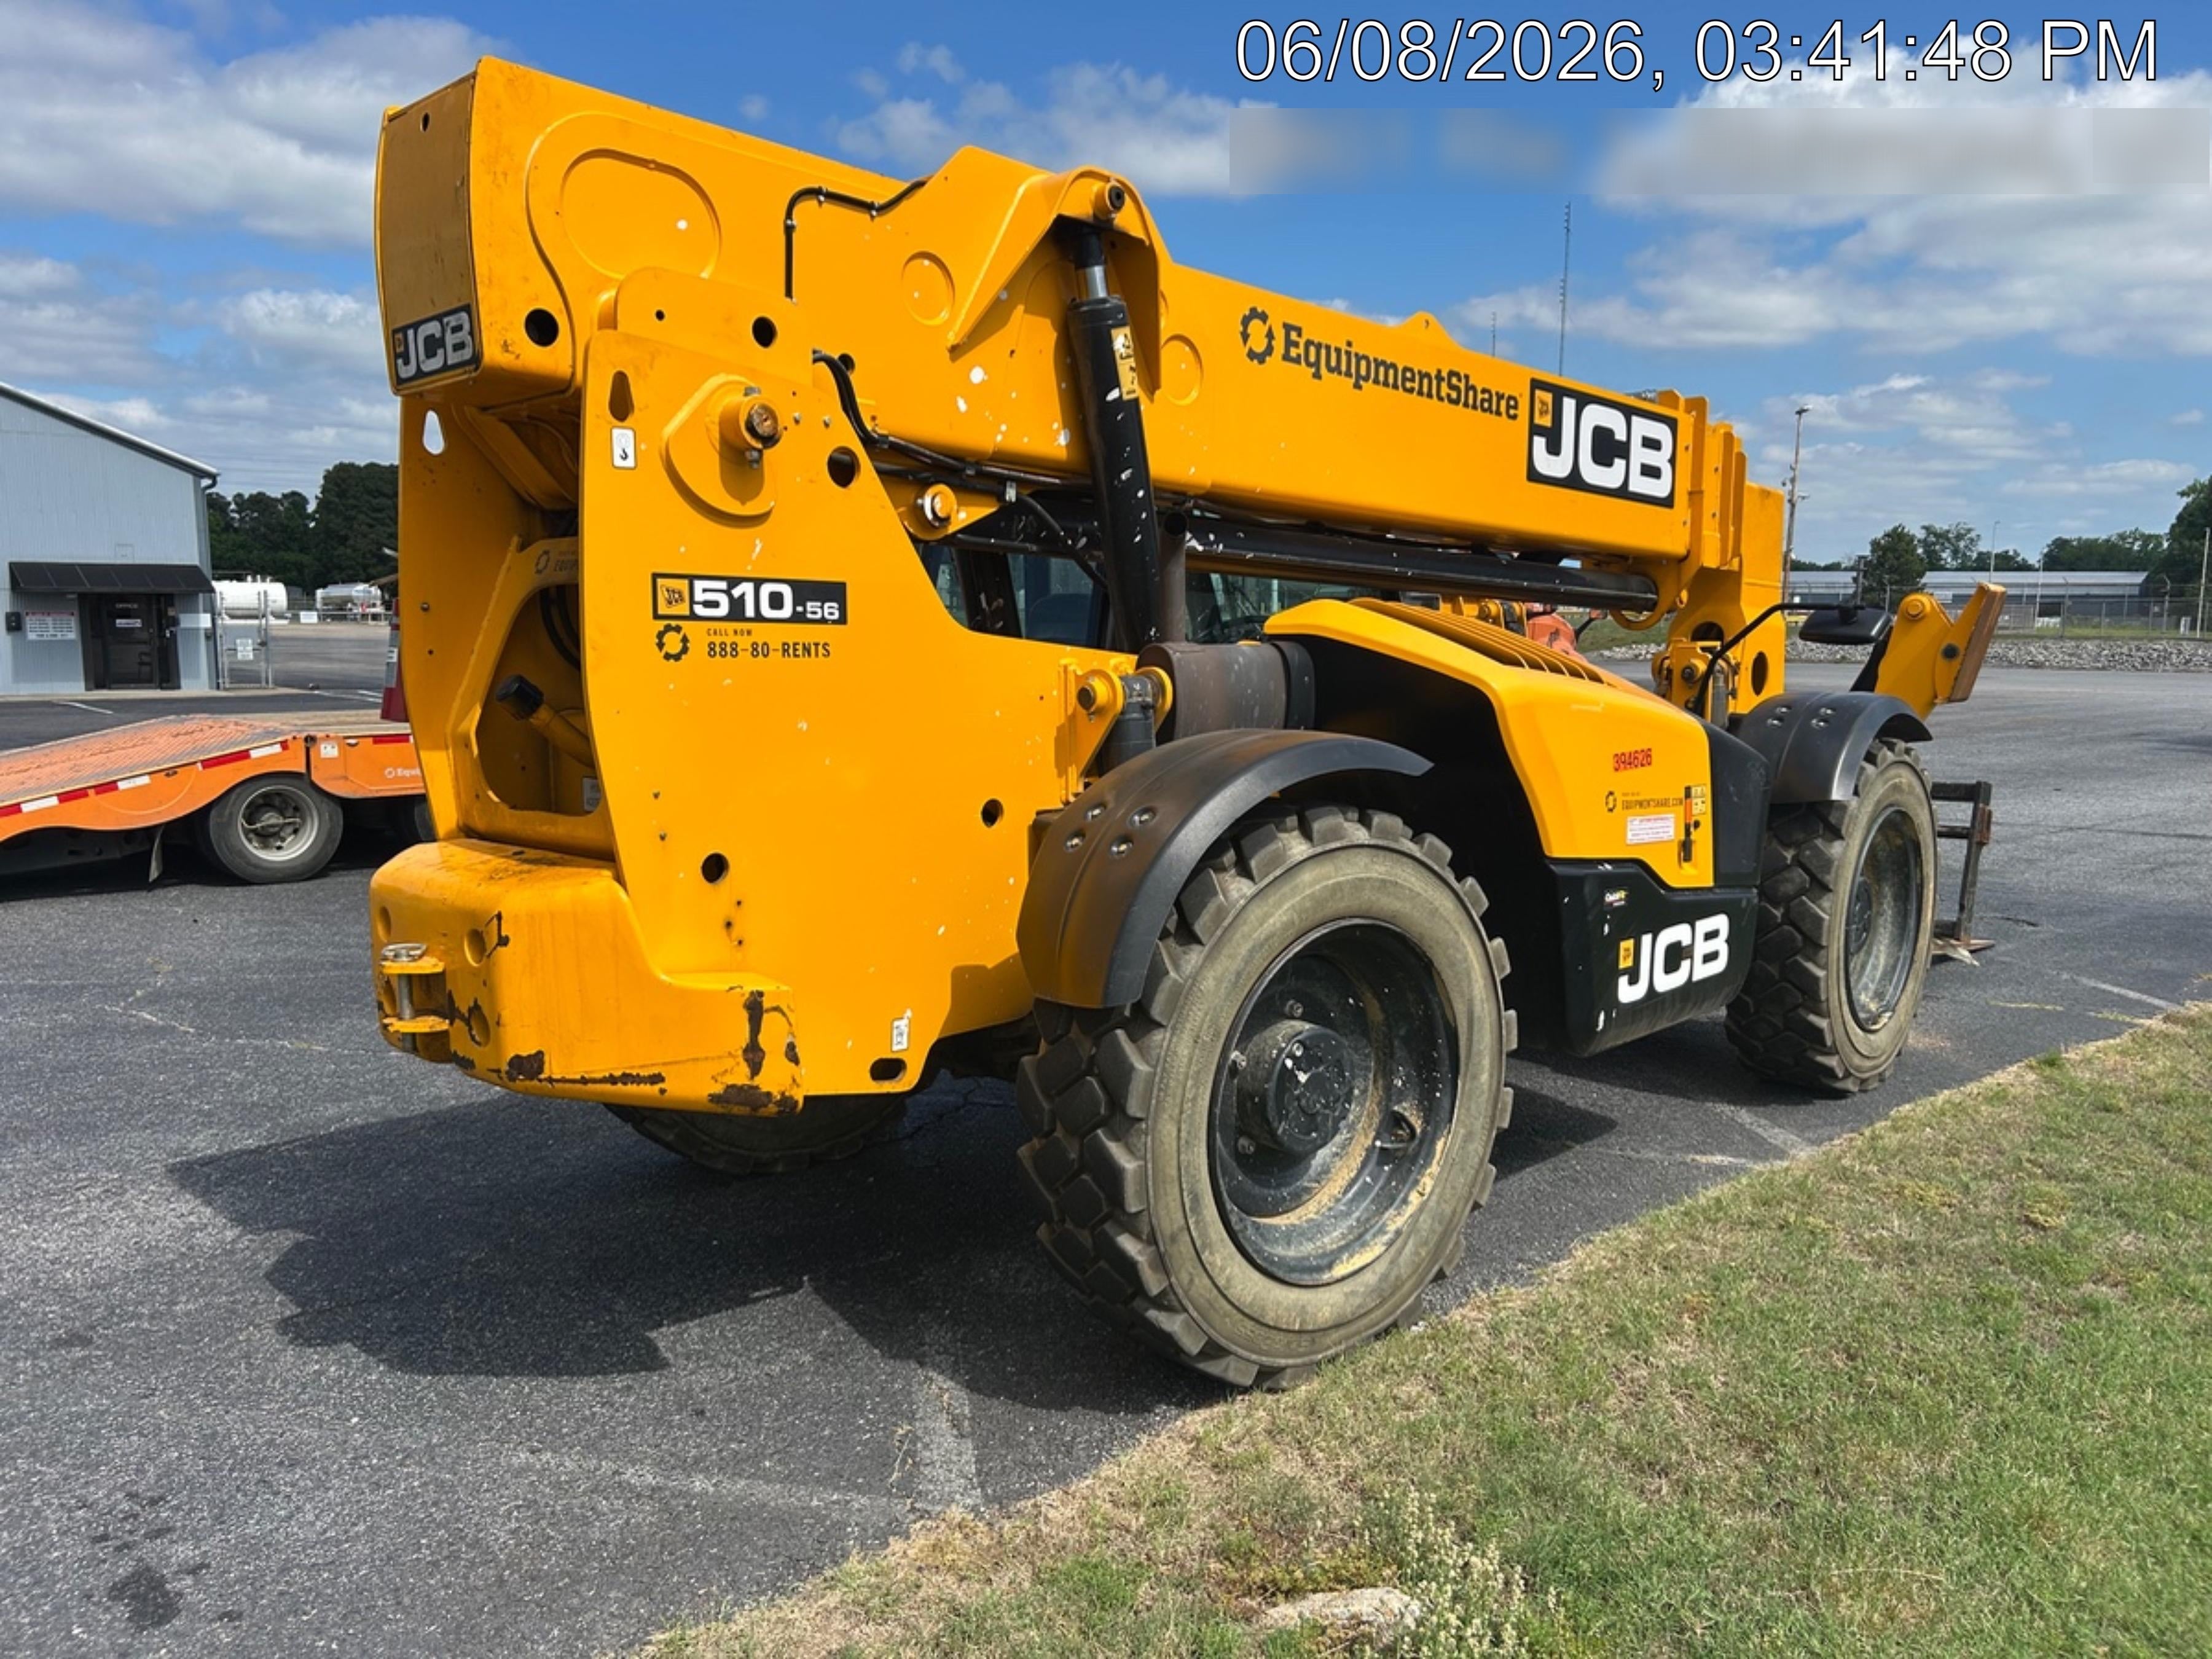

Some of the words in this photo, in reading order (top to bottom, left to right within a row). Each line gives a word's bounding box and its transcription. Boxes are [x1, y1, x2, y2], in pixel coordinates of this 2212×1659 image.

[396, 311, 473, 379] JCB
[1281, 321, 1520, 422] EquipmentShare
[1532, 396, 1675, 500] JCB
[692, 579, 840, 620] 510-56
[707, 628, 729, 637] CALL
[707, 641, 831, 659] 888-80-RENTS
[1613, 748, 1652, 772] 394626
[1618, 914, 1730, 1004] JCB
